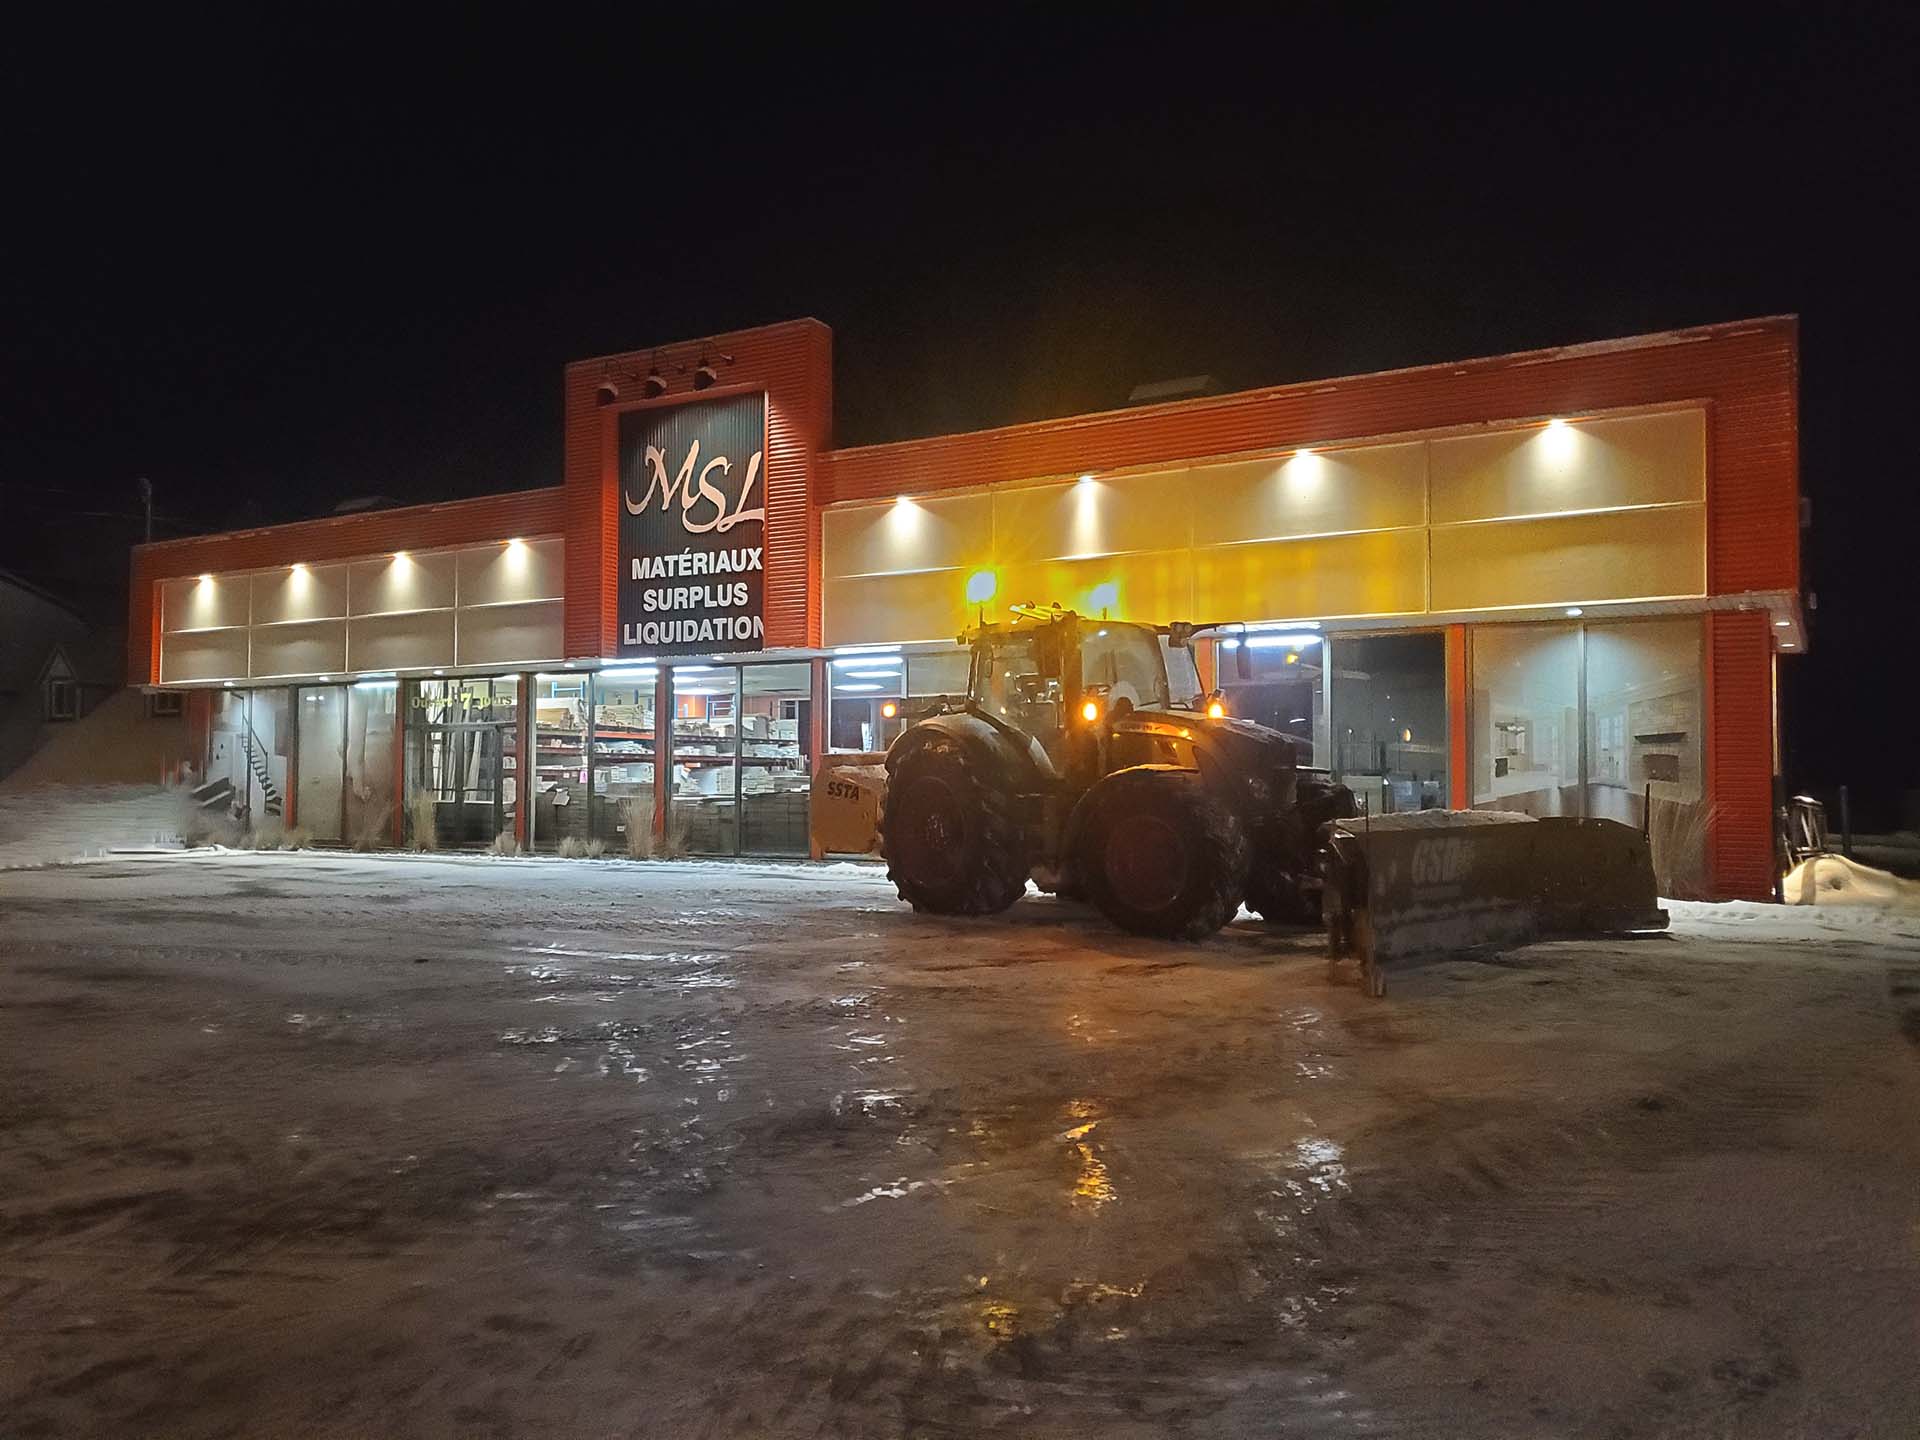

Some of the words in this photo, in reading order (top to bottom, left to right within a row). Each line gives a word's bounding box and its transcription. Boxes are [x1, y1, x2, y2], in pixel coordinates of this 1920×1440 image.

[625, 439, 764, 533] MSL
[631, 547, 763, 580] MATÉRIAUX
[642, 582, 748, 612] SURPLUS
[623, 615, 764, 645] LIQUIDATION
[460, 692, 472, 710] 7
